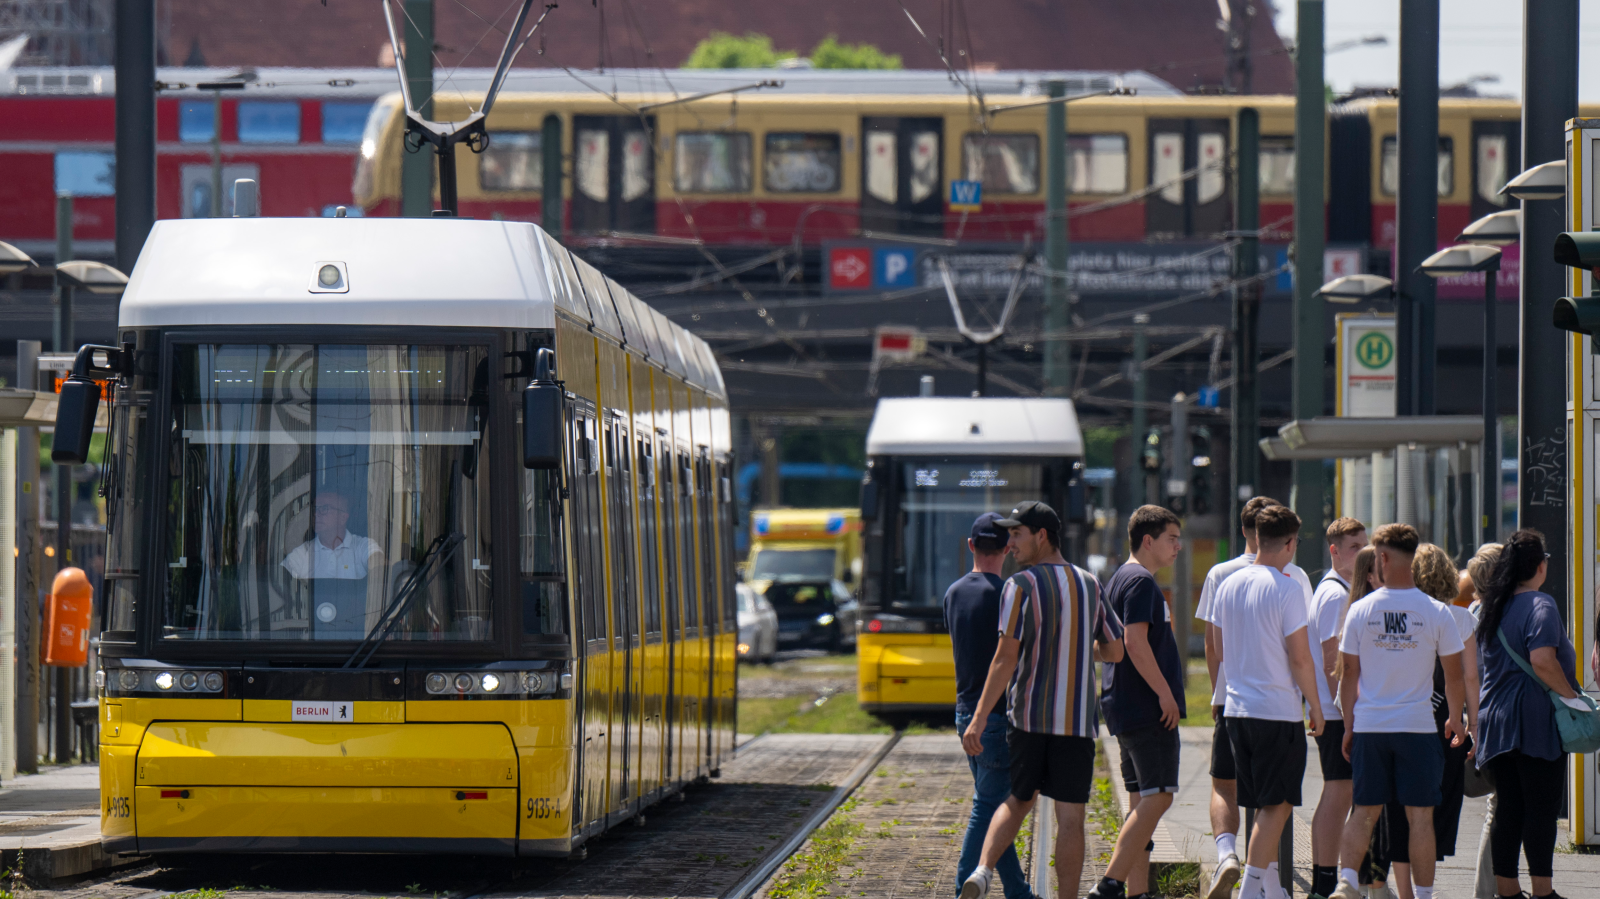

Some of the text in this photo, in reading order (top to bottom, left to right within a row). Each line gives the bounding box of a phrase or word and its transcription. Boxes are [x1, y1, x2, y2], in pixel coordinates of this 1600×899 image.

[954, 182, 978, 202] W
[885, 253, 908, 284] P
[1366, 341, 1383, 360] H
[1383, 612, 1408, 634] VANS
[296, 707, 329, 716] BERLIN
[107, 796, 130, 818] A-9135
[527, 797, 561, 819] 9135-A
